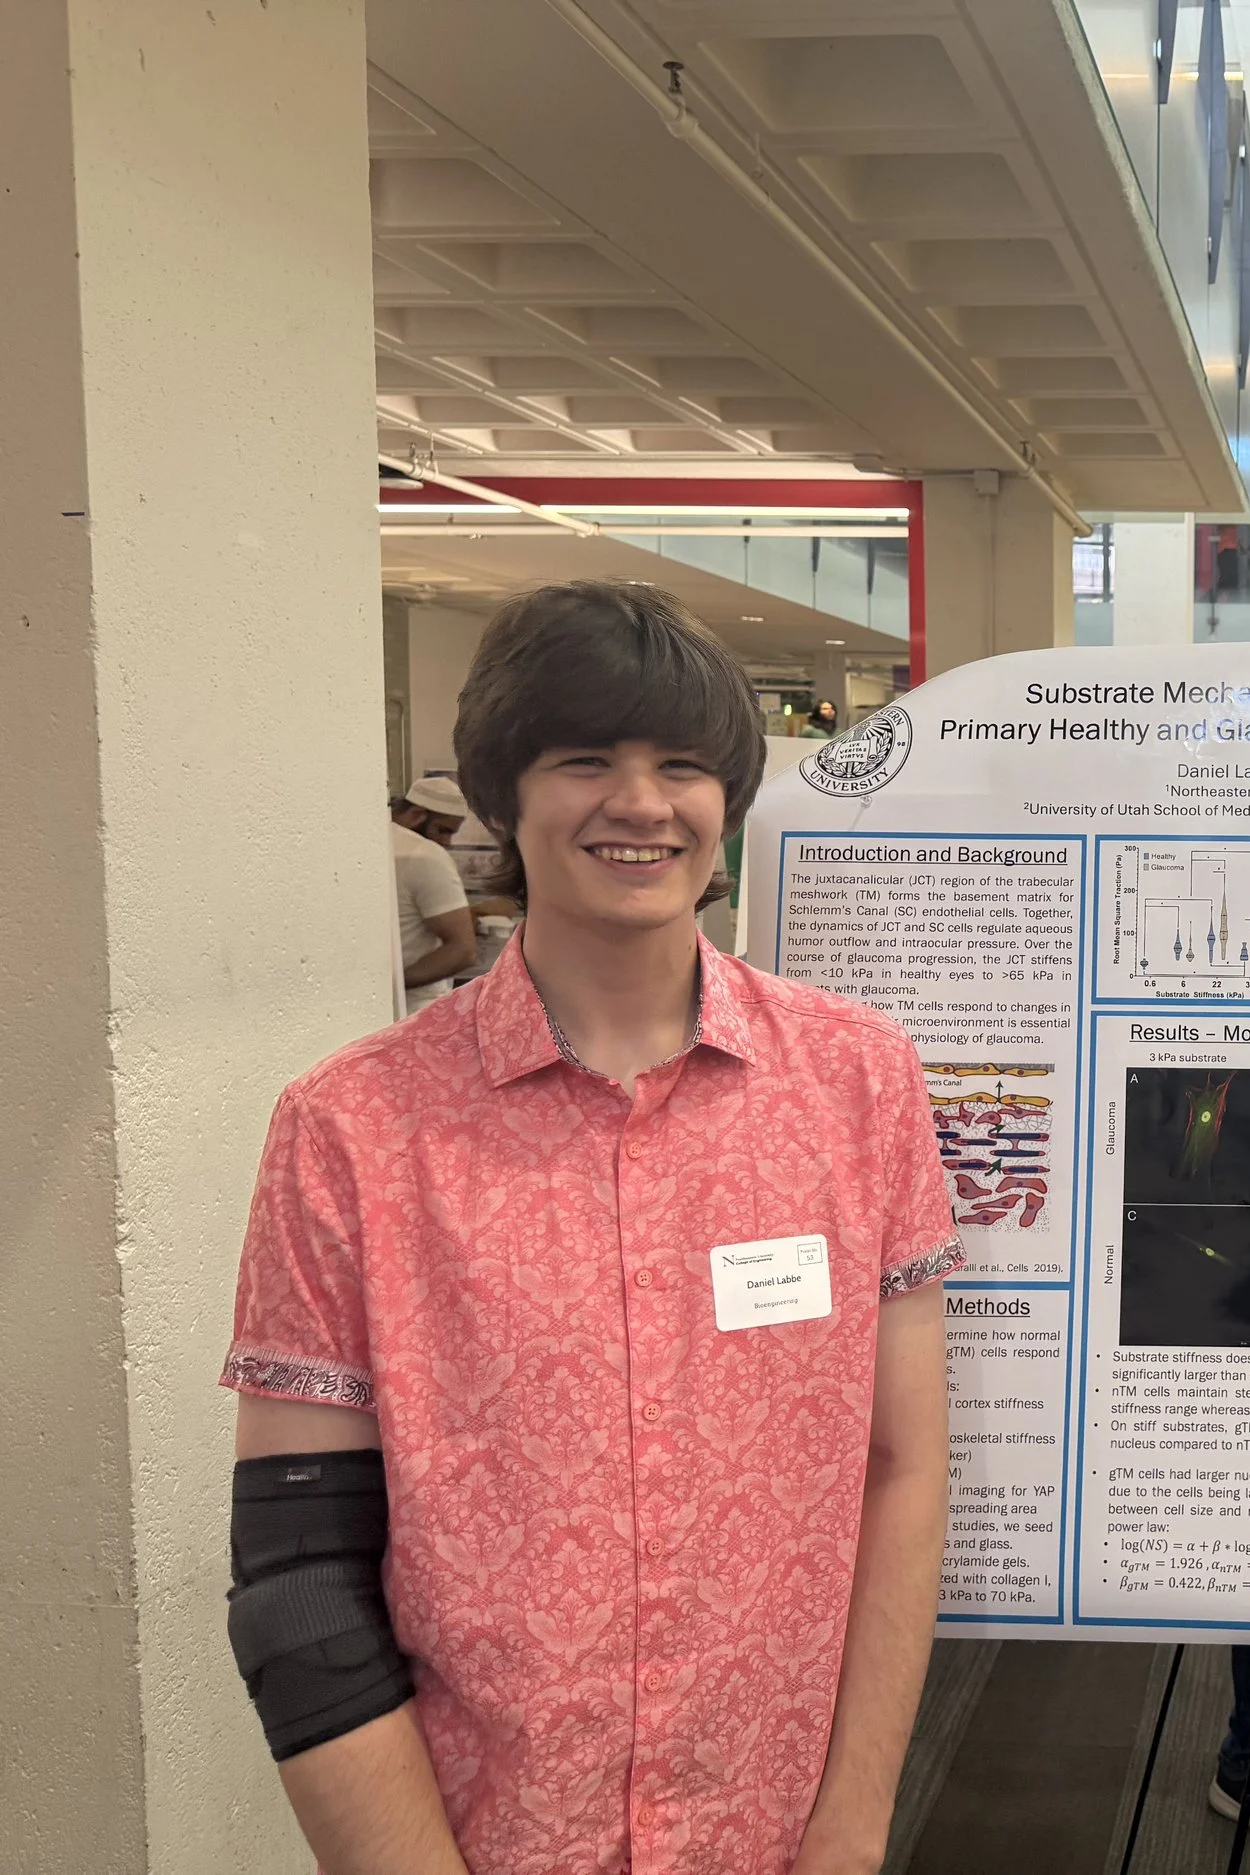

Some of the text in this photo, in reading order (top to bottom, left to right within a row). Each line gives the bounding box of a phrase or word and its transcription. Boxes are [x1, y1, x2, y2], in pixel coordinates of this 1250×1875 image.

[1025, 682, 1155, 705] Substrate
[940, 718, 1042, 745] Primary
[1050, 717, 1150, 746] Healthy
[1157, 718, 1207, 741] and
[810, 767, 889, 791] UNIVERSITY
[1177, 763, 1229, 779] Daniel
[1100, 803, 1115, 816] of
[1117, 803, 1150, 816] Utah
[1153, 803, 1201, 816] School
[1204, 804, 1219, 817] of
[799, 844, 1067, 864] Introduction and Background
[1151, 853, 1176, 861] Healthy
[790, 873, 1075, 888] The juxtacanalicular (JCT) region of the trabecular
[1130, 1023, 1200, 1041] Results
[1149, 1052, 1227, 1063] 3 kPa substrate
[1130, 1074, 1138, 1084] A
[1106, 1101, 1117, 1155] Glaucoma
[1127, 1210, 1137, 1221] C
[1104, 1244, 1115, 1285] Normal
[747, 1275, 802, 1290] Daniel Labbe
[754, 1298, 798, 1310] Bioengineering
[946, 1297, 1031, 1316] Methods
